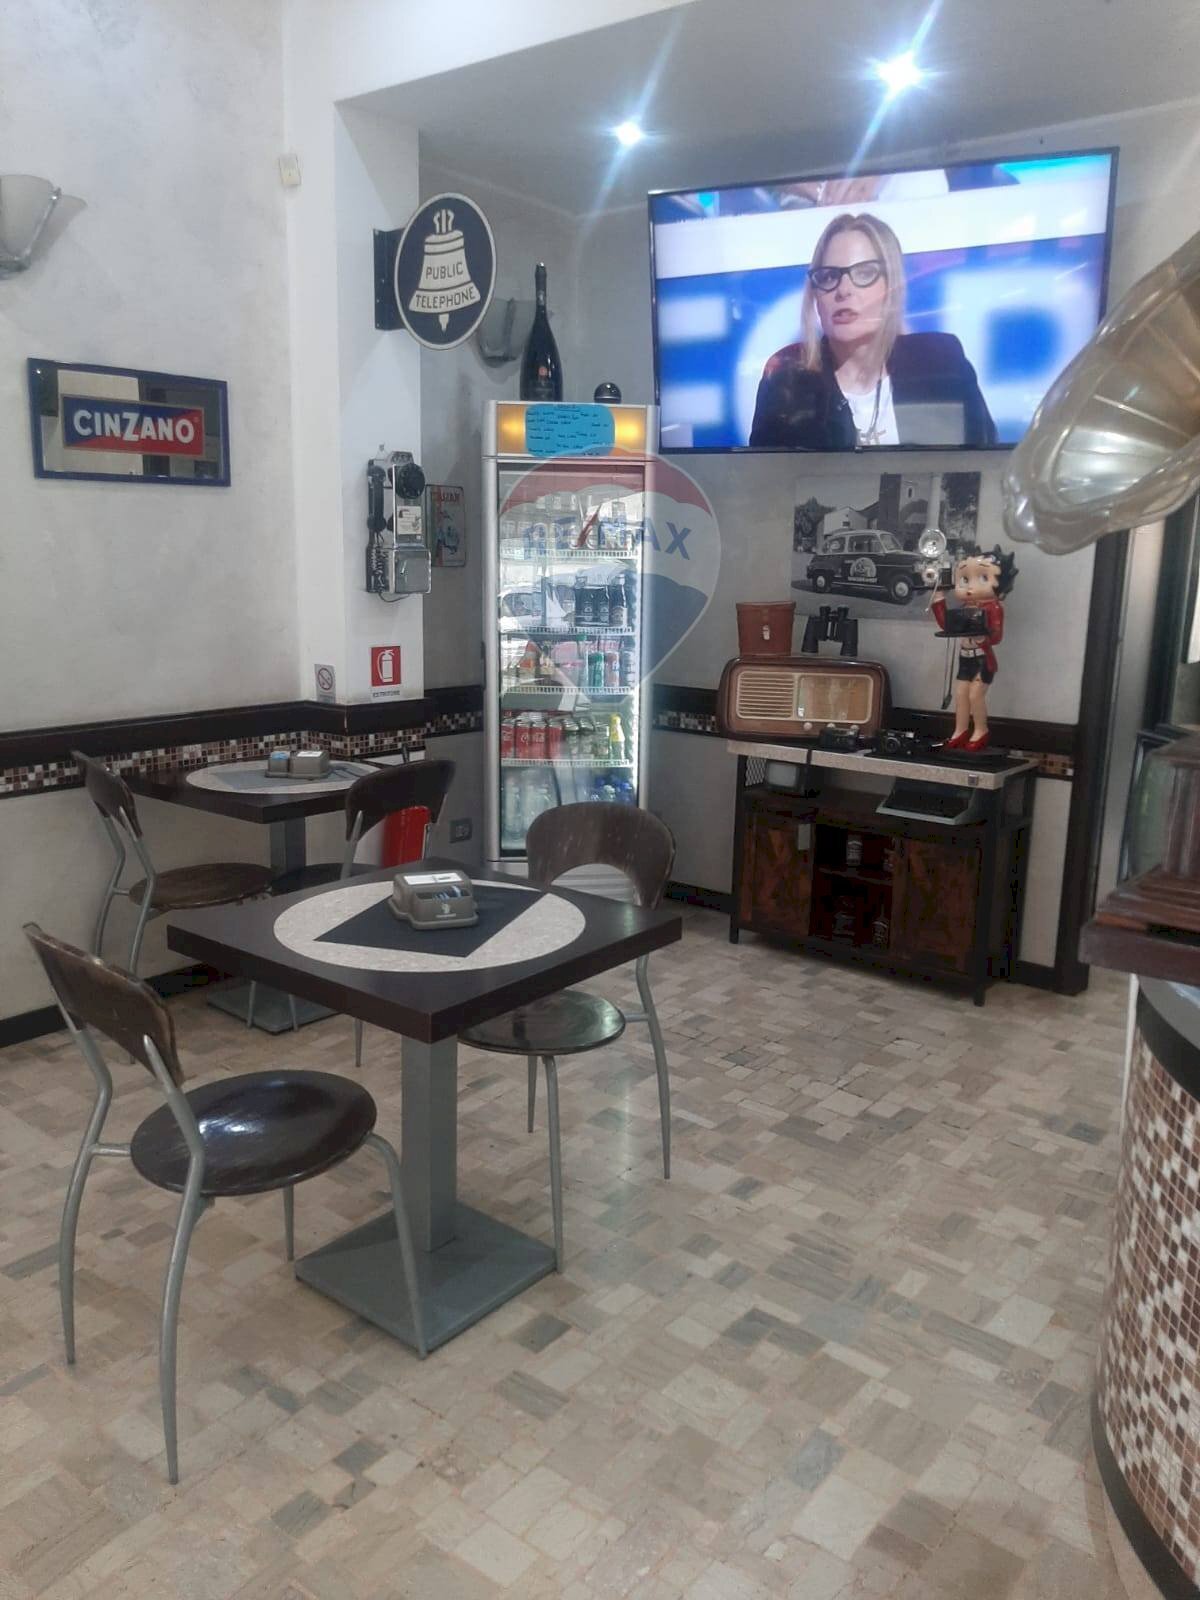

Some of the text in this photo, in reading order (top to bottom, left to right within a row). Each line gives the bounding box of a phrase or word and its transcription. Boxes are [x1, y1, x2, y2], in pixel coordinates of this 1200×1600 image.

[425, 262, 464, 280] PUBLIC
[415, 286, 476, 309] TELEPHONE
[73, 409, 195, 444] CINZANO
